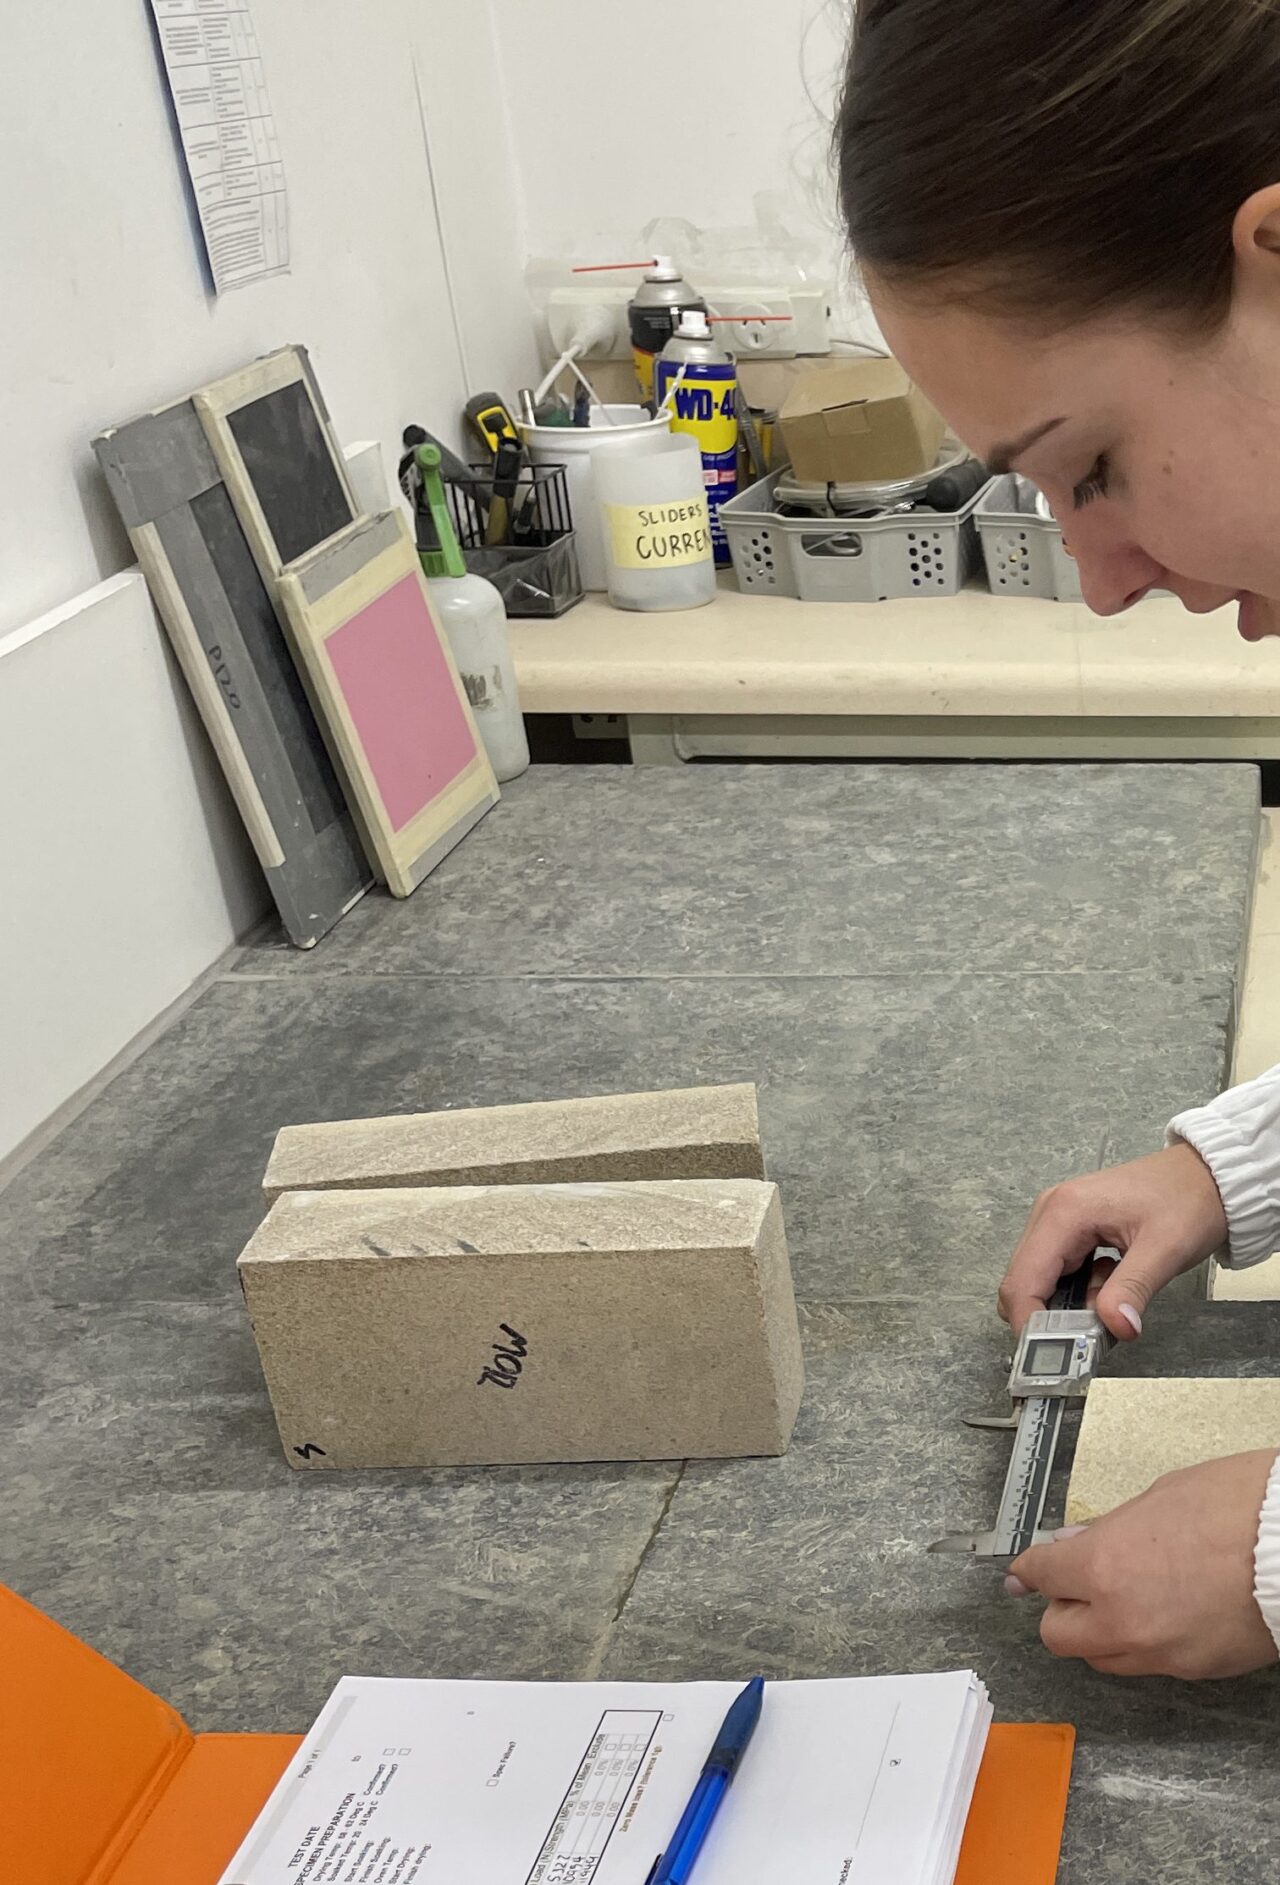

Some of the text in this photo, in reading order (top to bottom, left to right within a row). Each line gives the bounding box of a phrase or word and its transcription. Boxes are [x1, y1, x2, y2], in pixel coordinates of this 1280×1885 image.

[638, 503, 702, 527] SLIDERS
[318, 1792, 356, 1846] PREPARATION
[288, 1825, 320, 1868] TEST DATE
